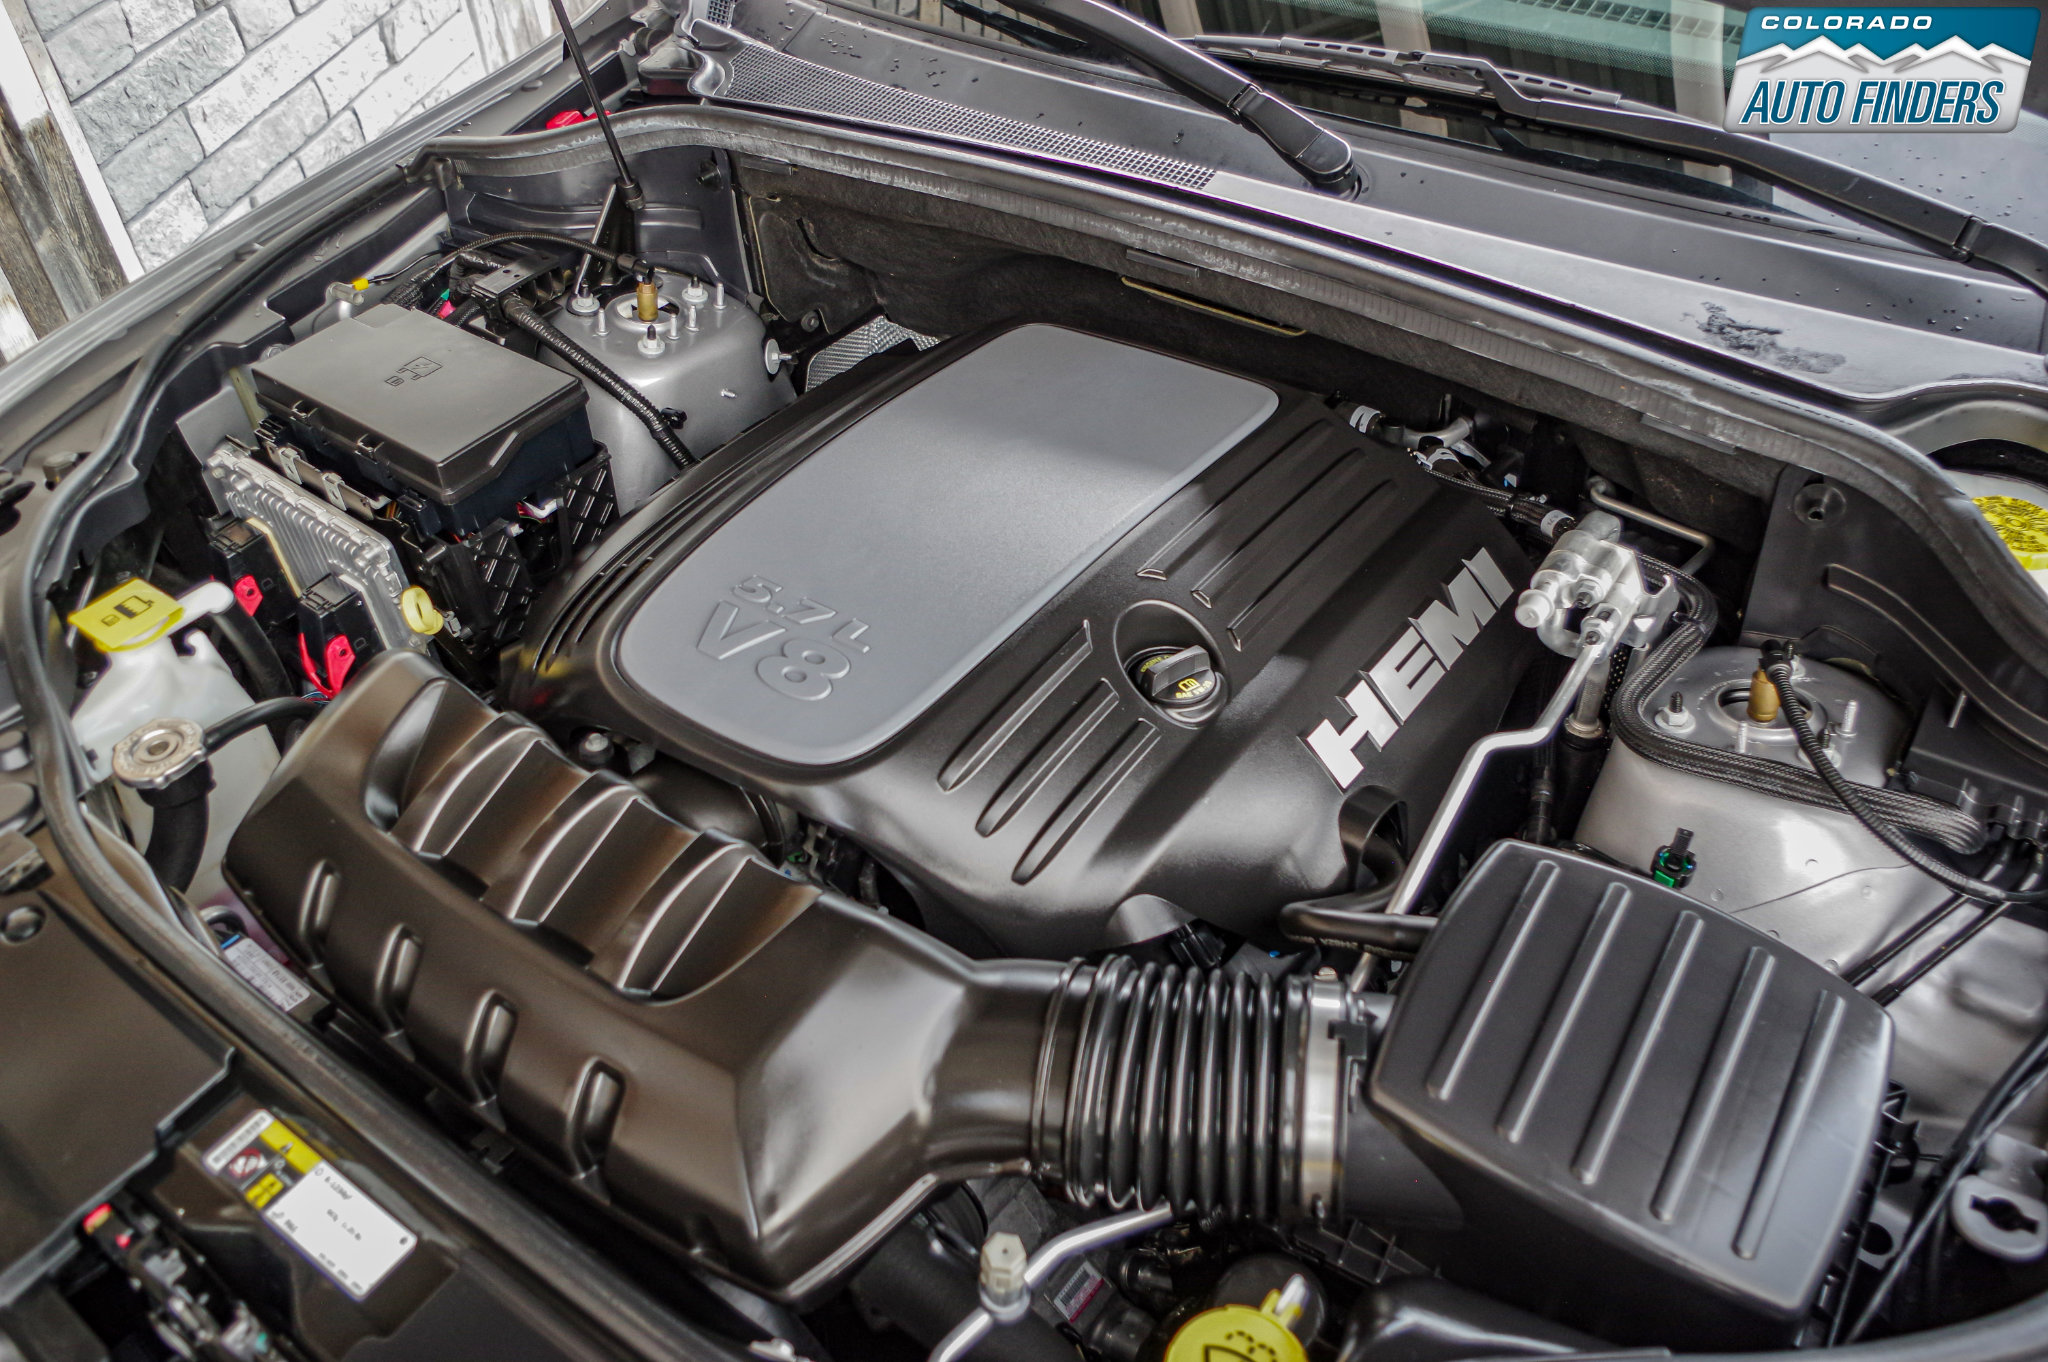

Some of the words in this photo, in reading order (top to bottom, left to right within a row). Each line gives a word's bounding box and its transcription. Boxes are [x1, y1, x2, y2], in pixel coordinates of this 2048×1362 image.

[696, 599, 851, 701] V8
[732, 574, 871, 653] 5.7L
[1298, 547, 1514, 794] HEMI
